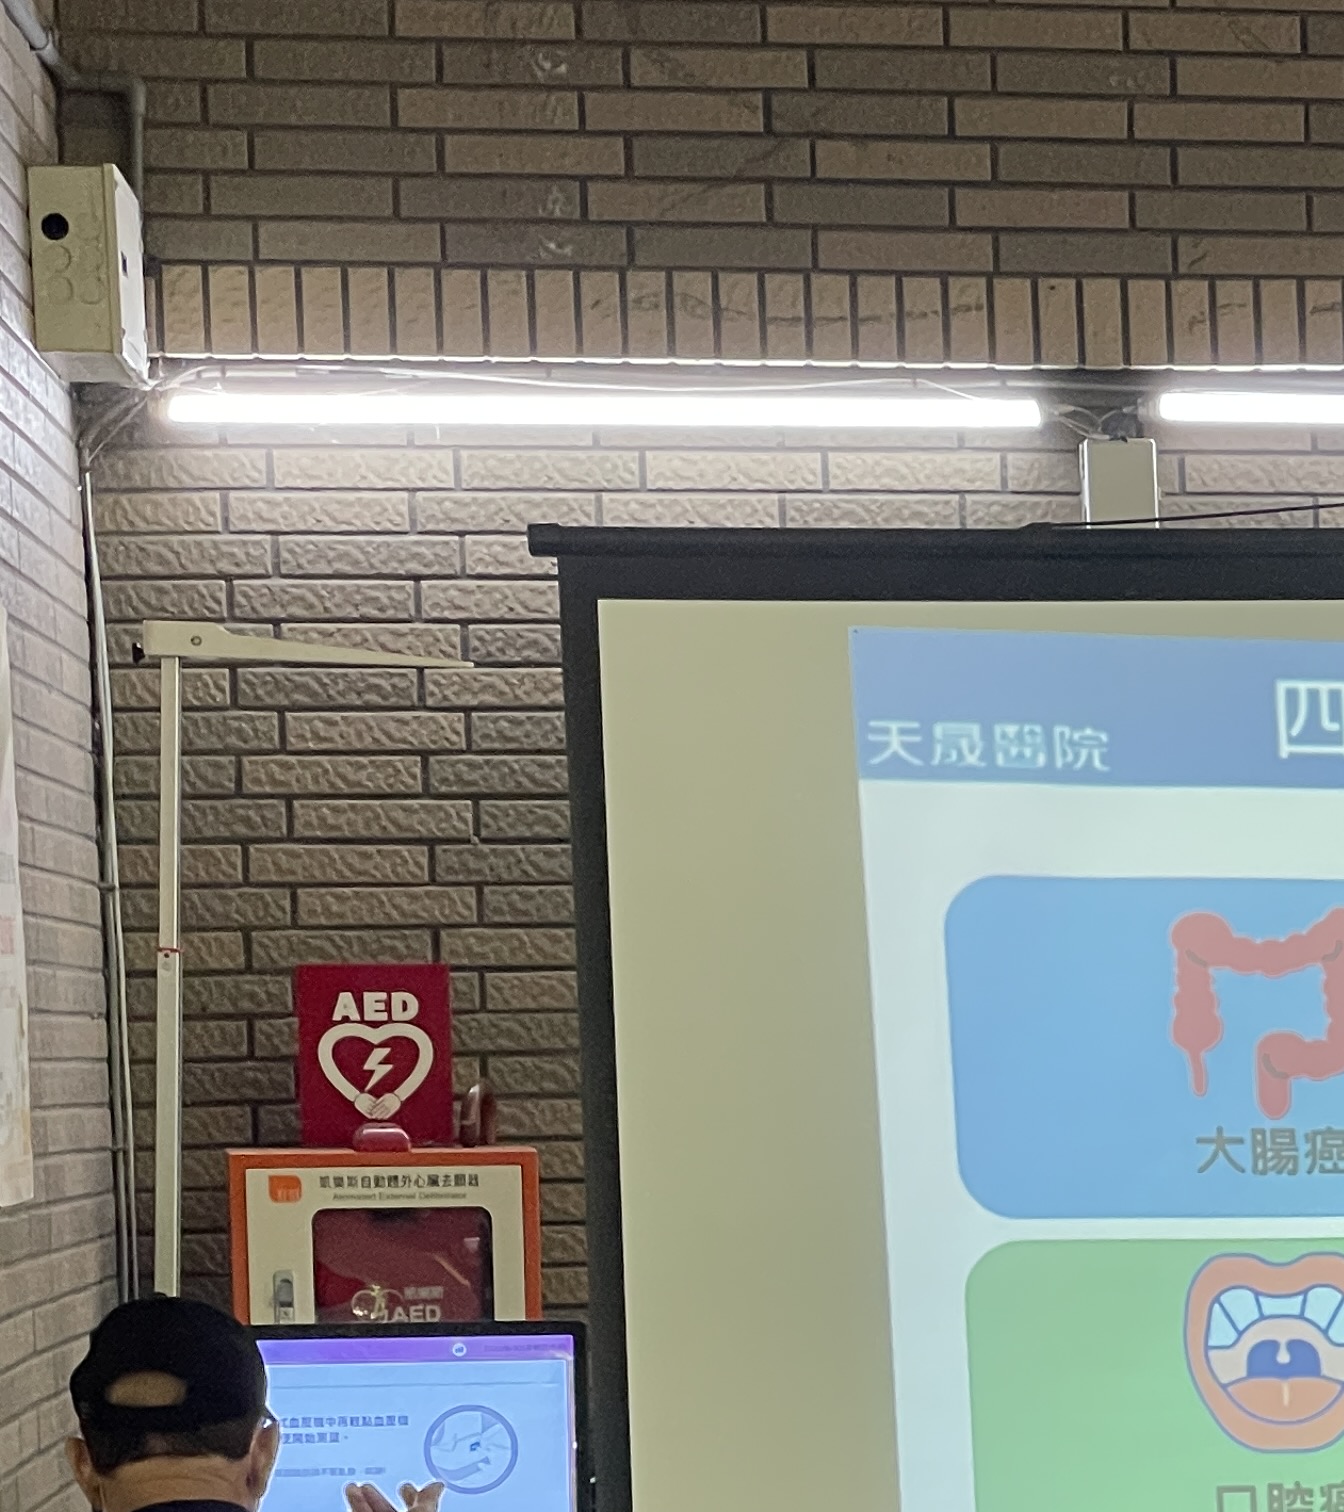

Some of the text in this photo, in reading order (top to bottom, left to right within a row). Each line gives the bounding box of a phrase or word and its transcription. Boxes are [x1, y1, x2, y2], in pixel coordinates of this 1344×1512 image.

[867, 720, 1111, 772] 天晟醫院
[332, 991, 419, 1021] AED
[391, 1304, 441, 1322] AED
